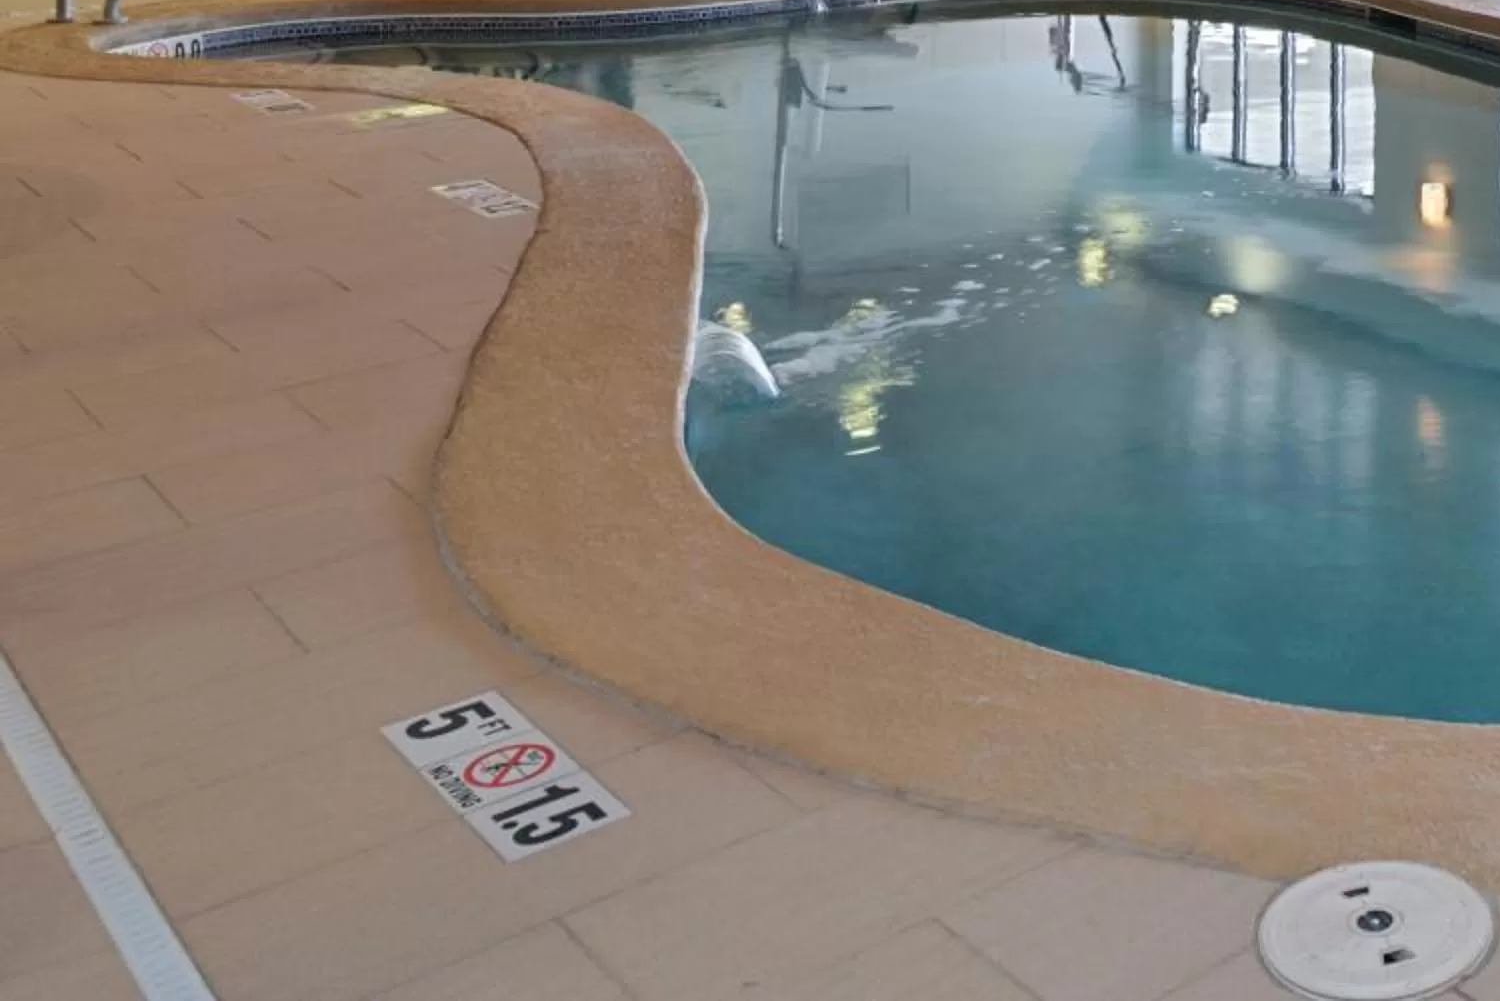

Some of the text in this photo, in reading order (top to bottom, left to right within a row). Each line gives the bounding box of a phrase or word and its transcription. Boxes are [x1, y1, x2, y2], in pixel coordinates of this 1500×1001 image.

[405, 700, 512, 739] 5 FT
[491, 784, 607, 846] 1.5
